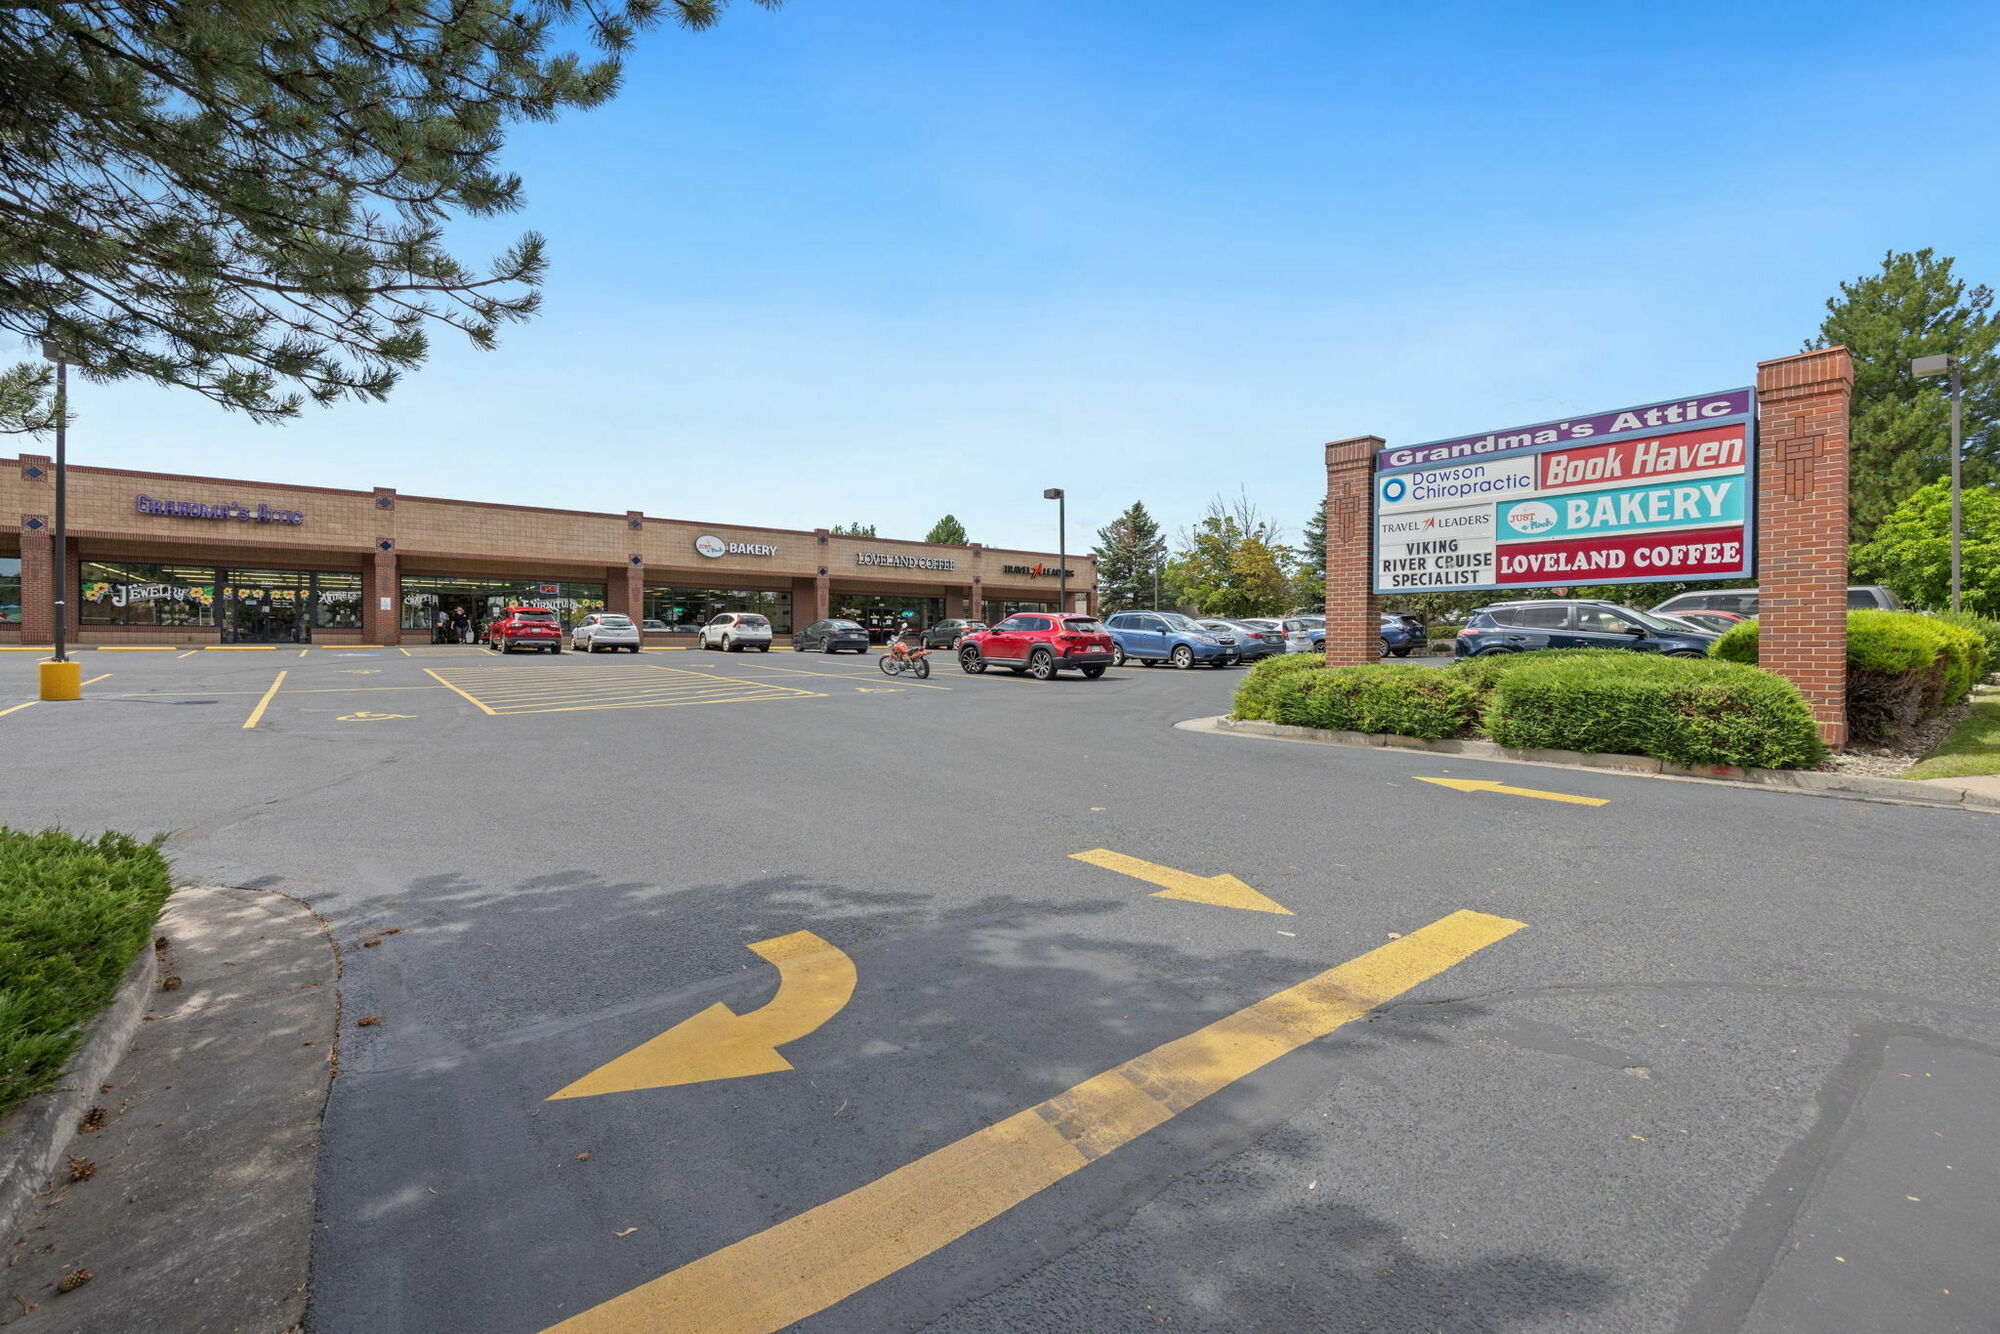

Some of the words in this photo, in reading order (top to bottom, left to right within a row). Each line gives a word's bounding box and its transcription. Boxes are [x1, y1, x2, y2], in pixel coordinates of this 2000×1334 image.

[1389, 422, 1594, 467] Grandma's
[1609, 400, 1732, 433] Attic
[1546, 447, 1624, 486] Book
[1632, 438, 1743, 475] Haven
[1412, 465, 1485, 486] Dawson
[1412, 473, 1531, 500] Chiropractic
[1566, 482, 1732, 530] BAKERY
[1382, 522, 1420, 533] TRAVEL
[1438, 514, 1489, 528] LEADERS
[1509, 512, 1536, 523] JUST
[729, 542, 777, 557] BAKERY
[1406, 539, 1458, 555] VIKING
[857, 552, 917, 569] LOVELAND
[918, 556, 956, 571] COFFEE
[1383, 558, 1426, 572] RIVER
[1435, 552, 1492, 569] CRUISE
[1500, 549, 1626, 574] LOVELAND
[1633, 542, 1740, 568] COFFEE
[1003, 564, 1030, 574] TRAVEL
[1043, 567, 1075, 577] LEADRS
[1392, 570, 1479, 587] SPECIALIST
